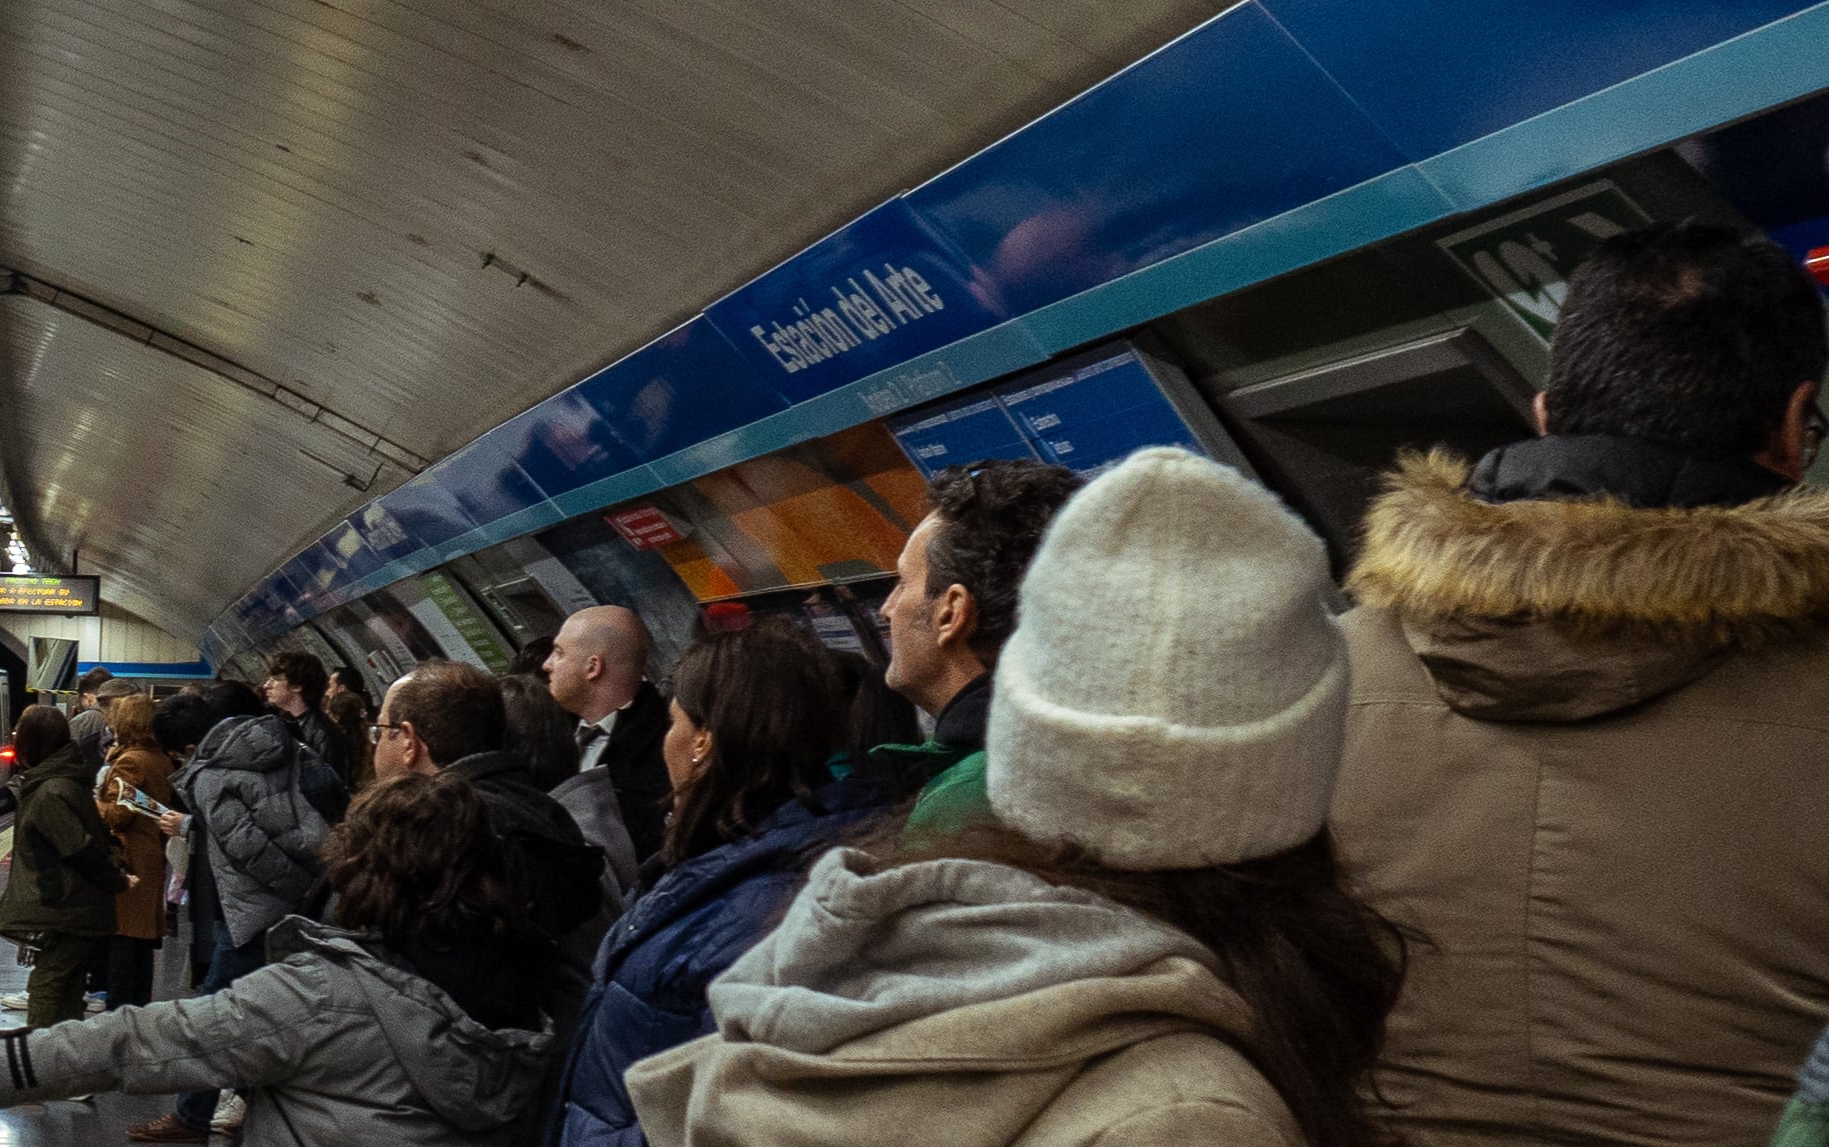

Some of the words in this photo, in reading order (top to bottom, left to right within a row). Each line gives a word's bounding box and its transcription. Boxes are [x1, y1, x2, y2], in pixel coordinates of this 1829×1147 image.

[830, 278, 897, 341] del
[863, 263, 945, 326] Arte
[750, 297, 862, 374] Estación
